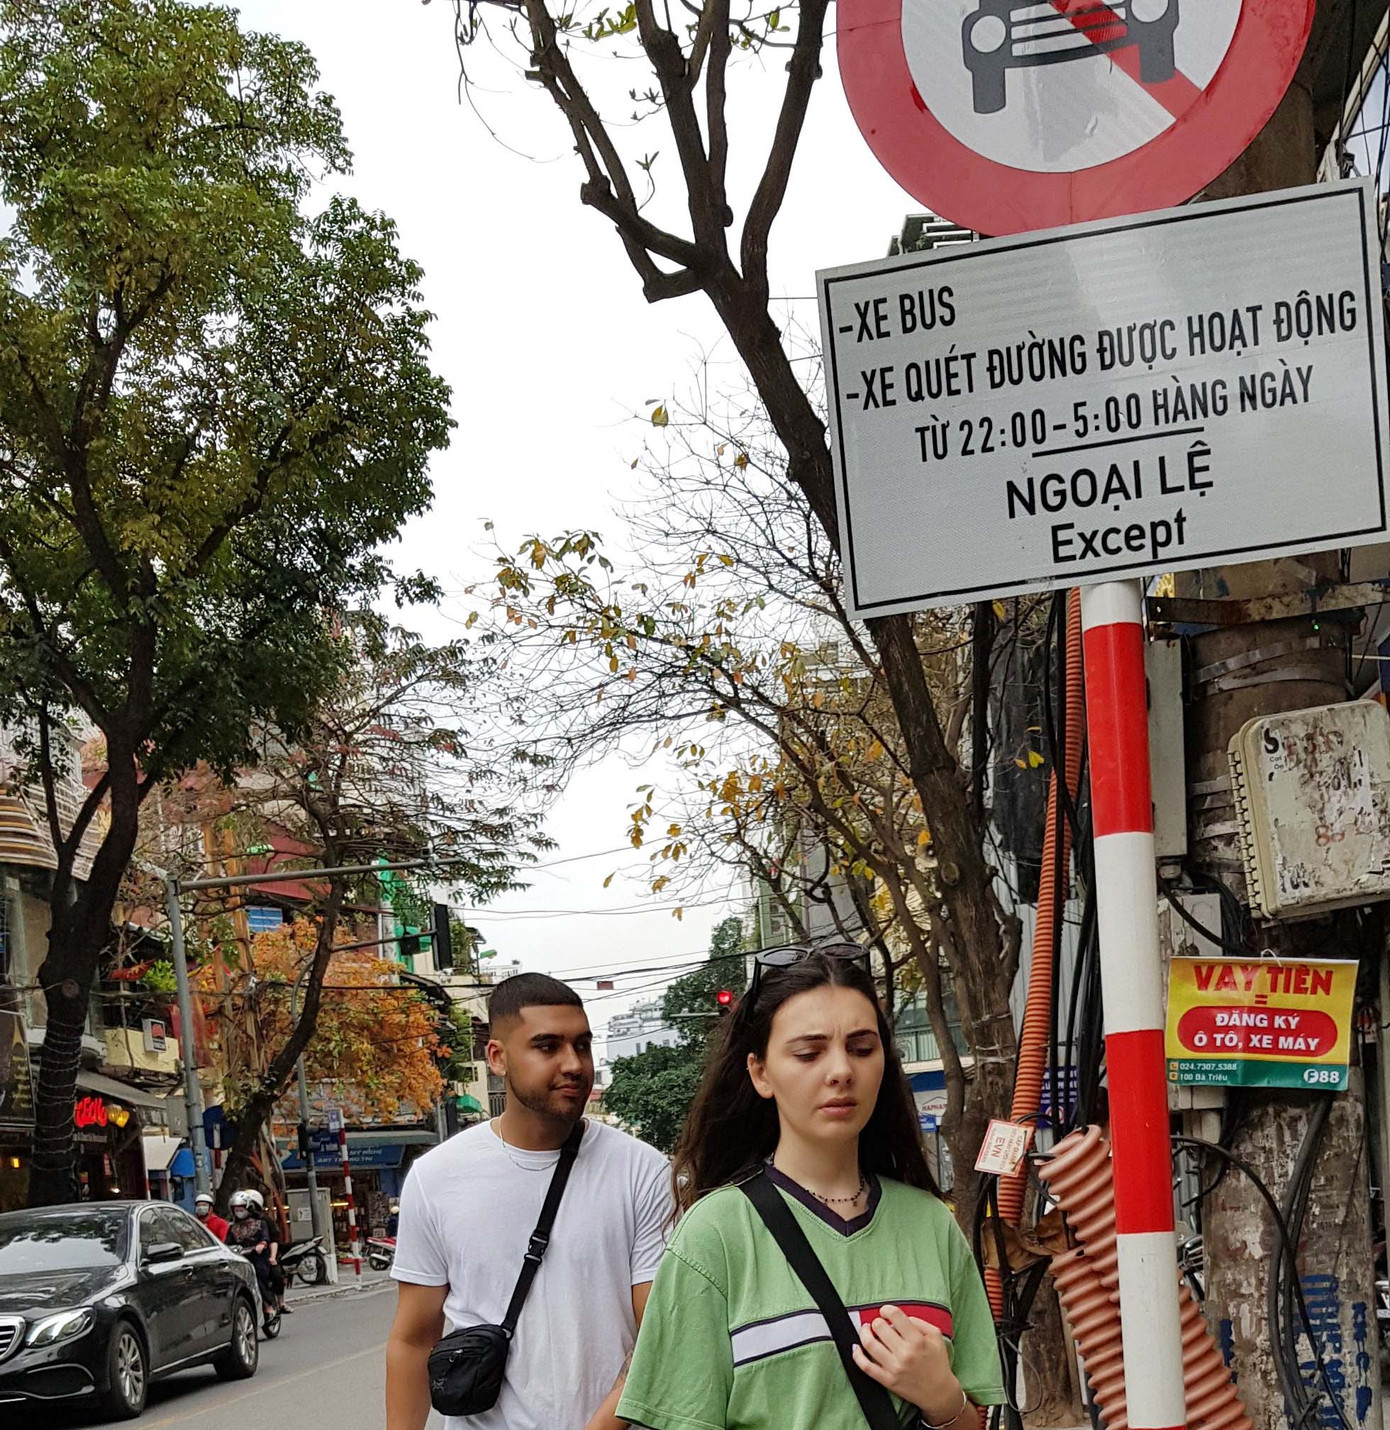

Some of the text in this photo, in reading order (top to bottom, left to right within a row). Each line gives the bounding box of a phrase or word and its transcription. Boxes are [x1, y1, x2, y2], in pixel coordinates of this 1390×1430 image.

[901, 286, 956, 329] BUS
[905, 345, 977, 401] QUÉT
[987, 330, 1087, 389] ĐƯỜNG
[1097, 319, 1177, 372] ĐƯỢC
[1187, 305, 1262, 357] HOẠT
[1273, 290, 1357, 343] ĐỘNG
[915, 414, 950, 463] TỪ
[1154, 375, 1228, 432] HÀNG
[1239, 360, 1313, 413] NGÀY
[1006, 440, 1214, 520] NGOẠI LỆ
[1051, 508, 1187, 563] Except
[1193, 964, 1260, 992] VAY
[1215, 1013, 1300, 1030] ĐĂNG KÝ
[1193, 1031, 1320, 1051] Ô TÔ, XE MÁY
[1179, 1073, 1194, 1081] 100
[990, 1136, 1005, 1158] EVN
